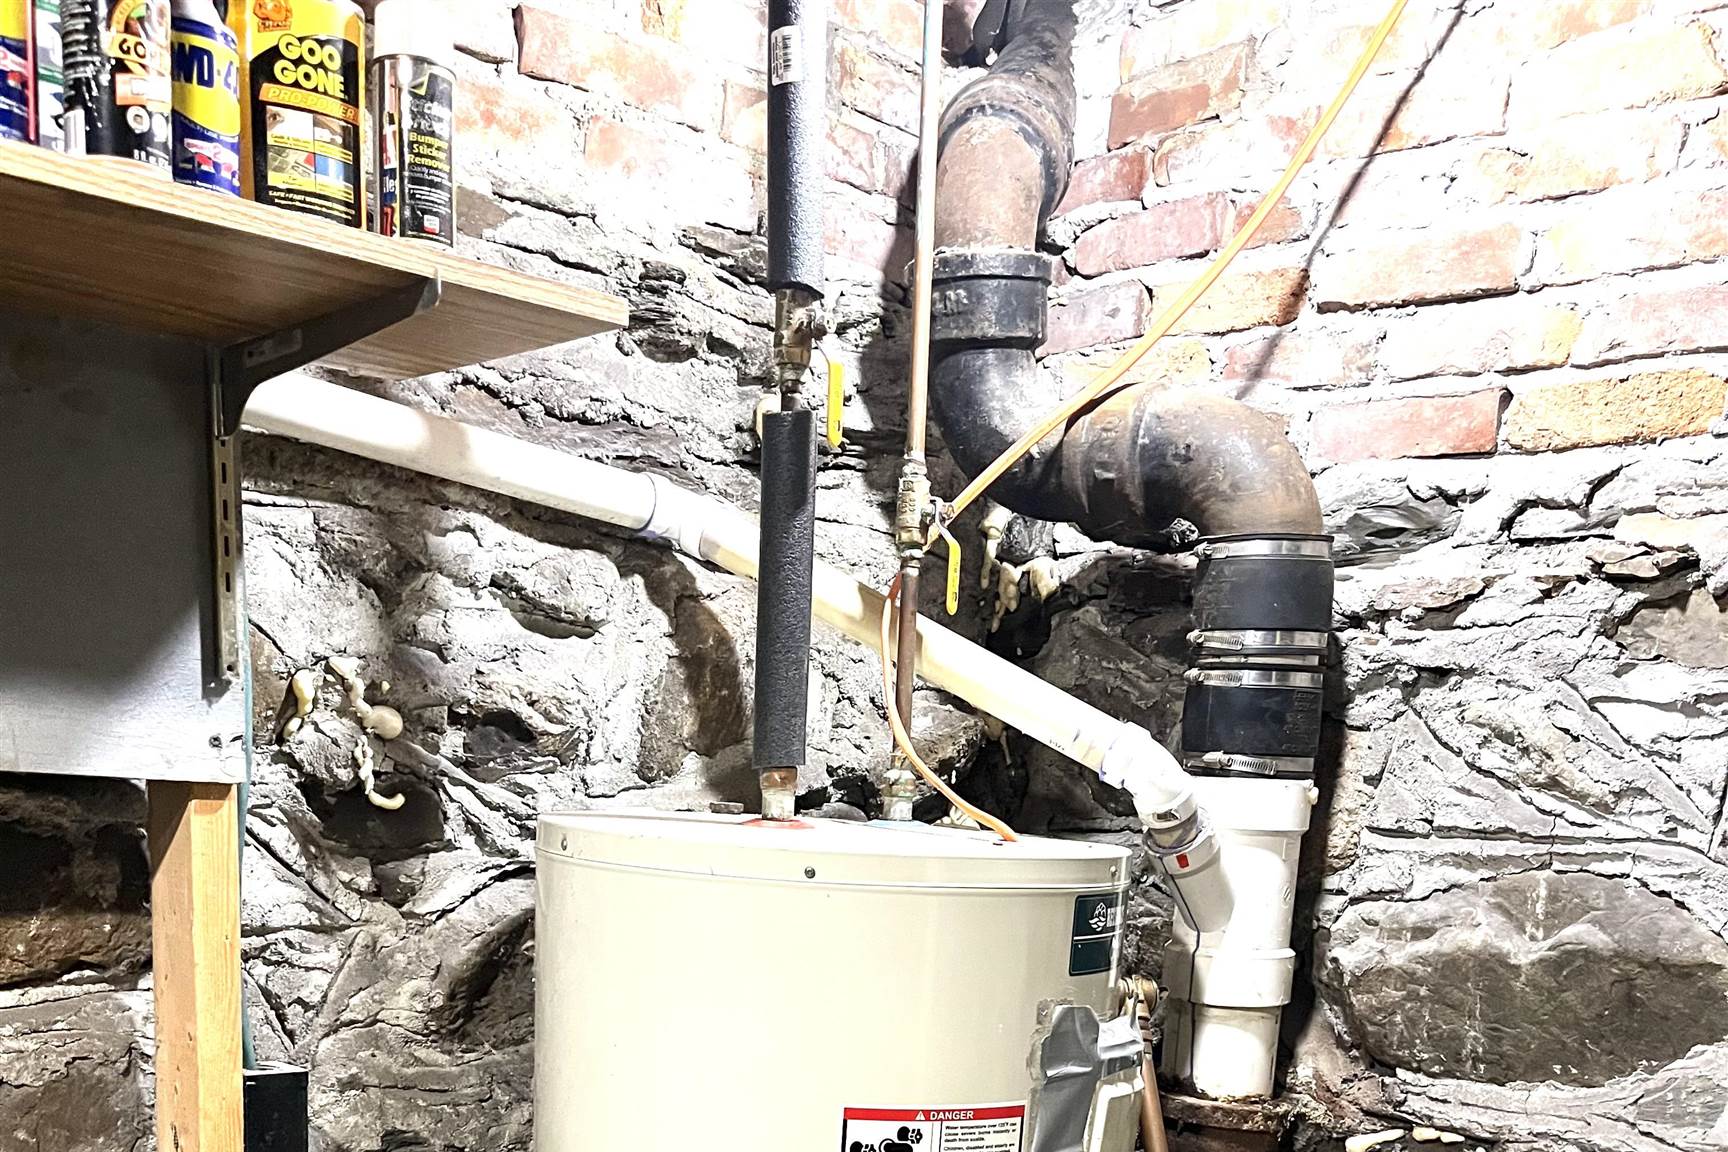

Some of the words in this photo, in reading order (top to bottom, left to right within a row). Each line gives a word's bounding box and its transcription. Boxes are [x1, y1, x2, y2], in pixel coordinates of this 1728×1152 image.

[278, 34, 341, 71] GOO
[274, 60, 345, 100] GONE
[409, 132, 448, 149] Bumper
[412, 144, 447, 160] Sticker
[408, 154, 450, 172] Remover
[930, 1110, 974, 1120] DANGER
